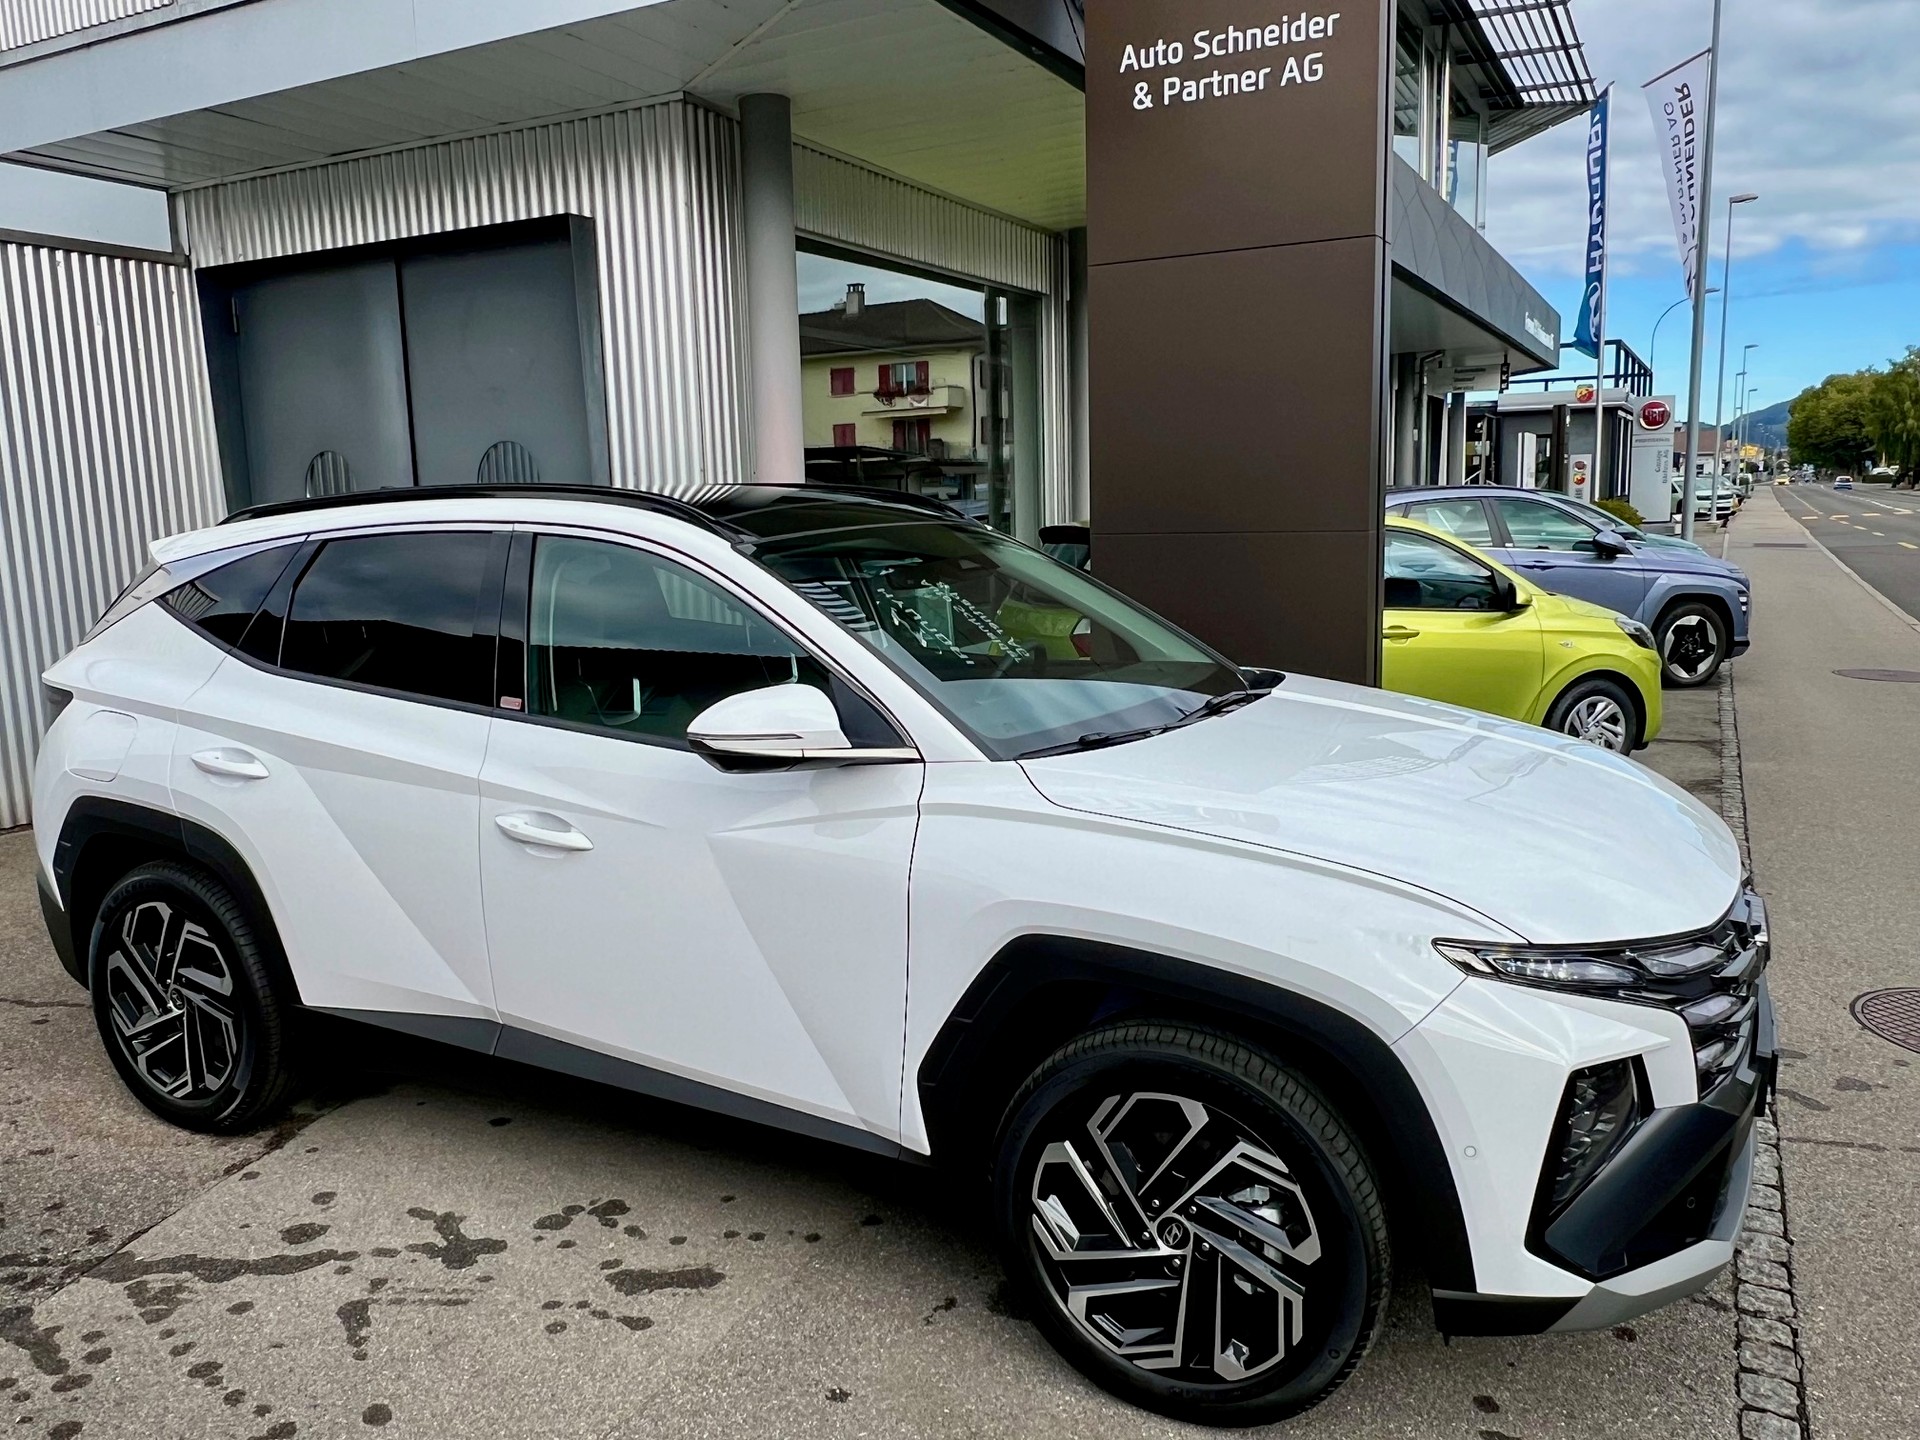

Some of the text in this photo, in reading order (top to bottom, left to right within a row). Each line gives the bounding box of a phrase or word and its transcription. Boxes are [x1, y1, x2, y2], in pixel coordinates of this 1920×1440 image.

[1120, 12, 1341, 74] Auto Schneider
[1132, 52, 1324, 110] & Partner AG
